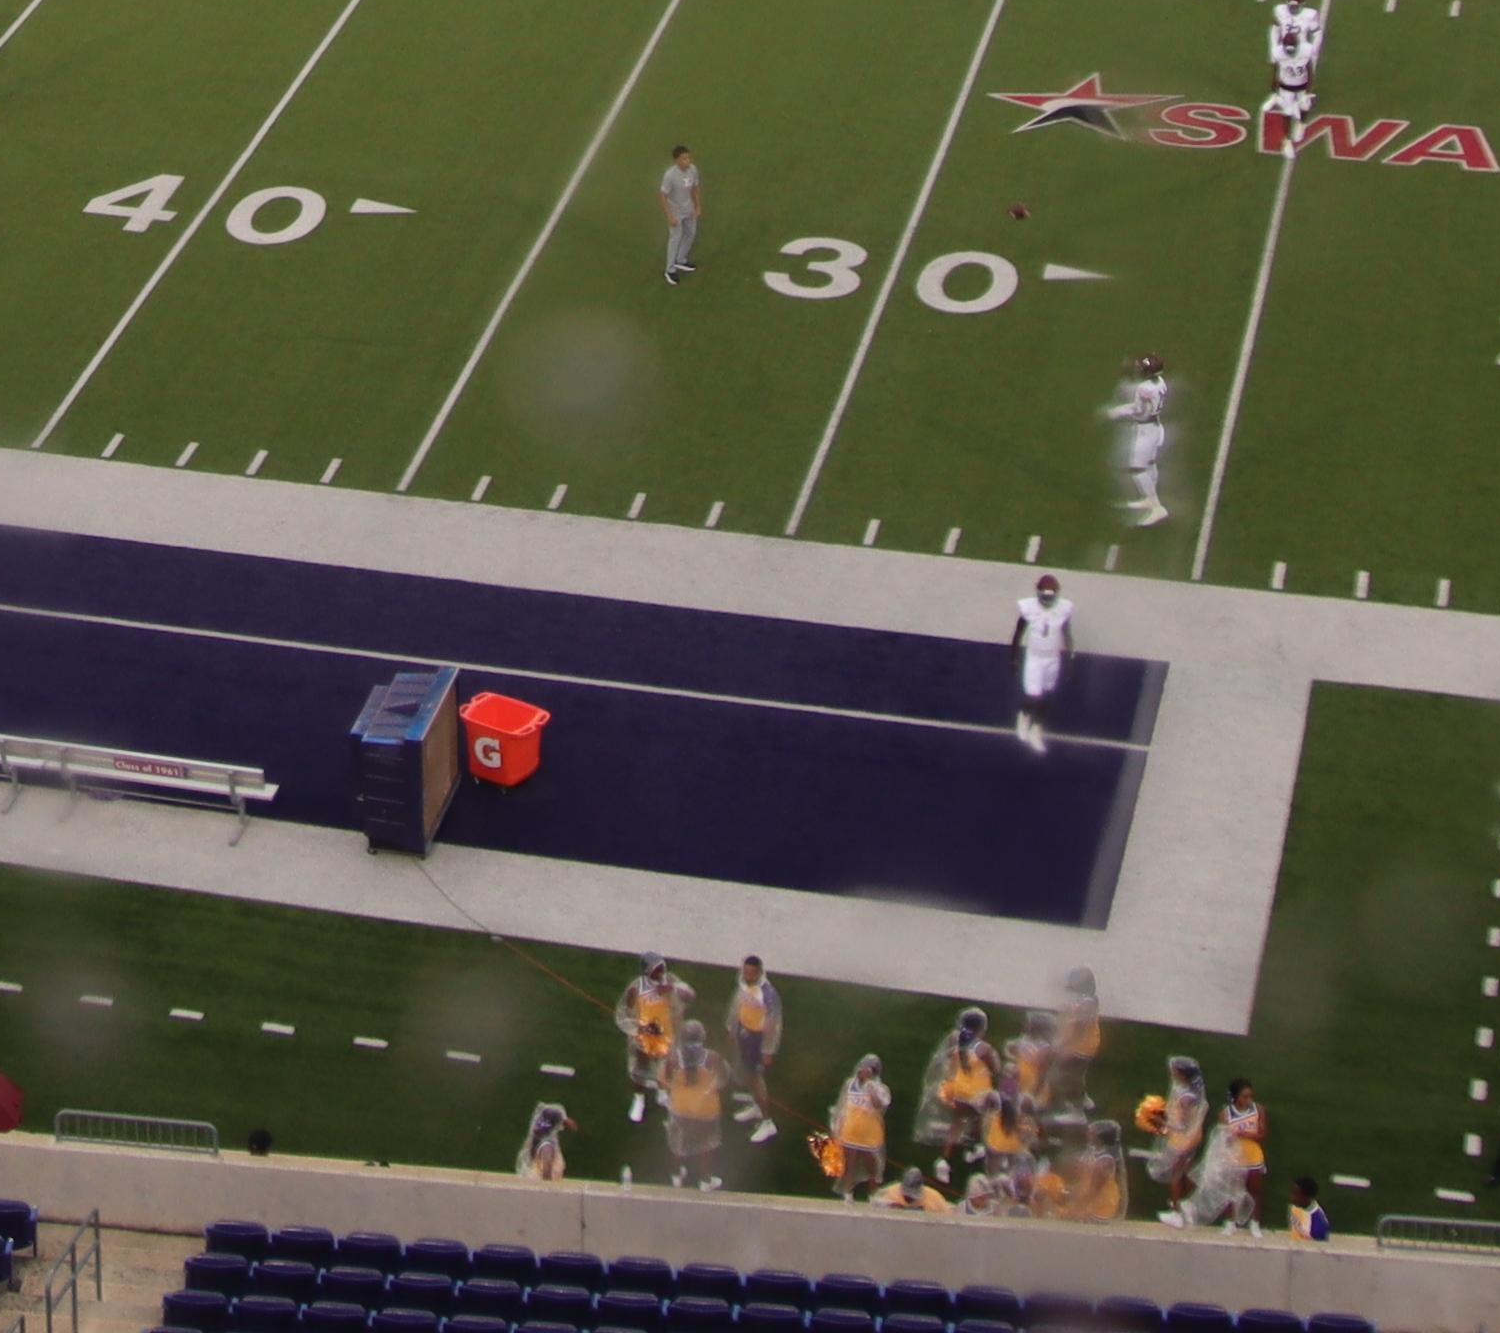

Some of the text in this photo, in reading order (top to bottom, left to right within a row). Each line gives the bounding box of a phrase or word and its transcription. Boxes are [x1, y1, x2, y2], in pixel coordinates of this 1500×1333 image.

[82, 173, 328, 245] 40
[762, 236, 1019, 314] 30
[115, 760, 179, 777] Class of 1961
[474, 736, 502, 768] G
